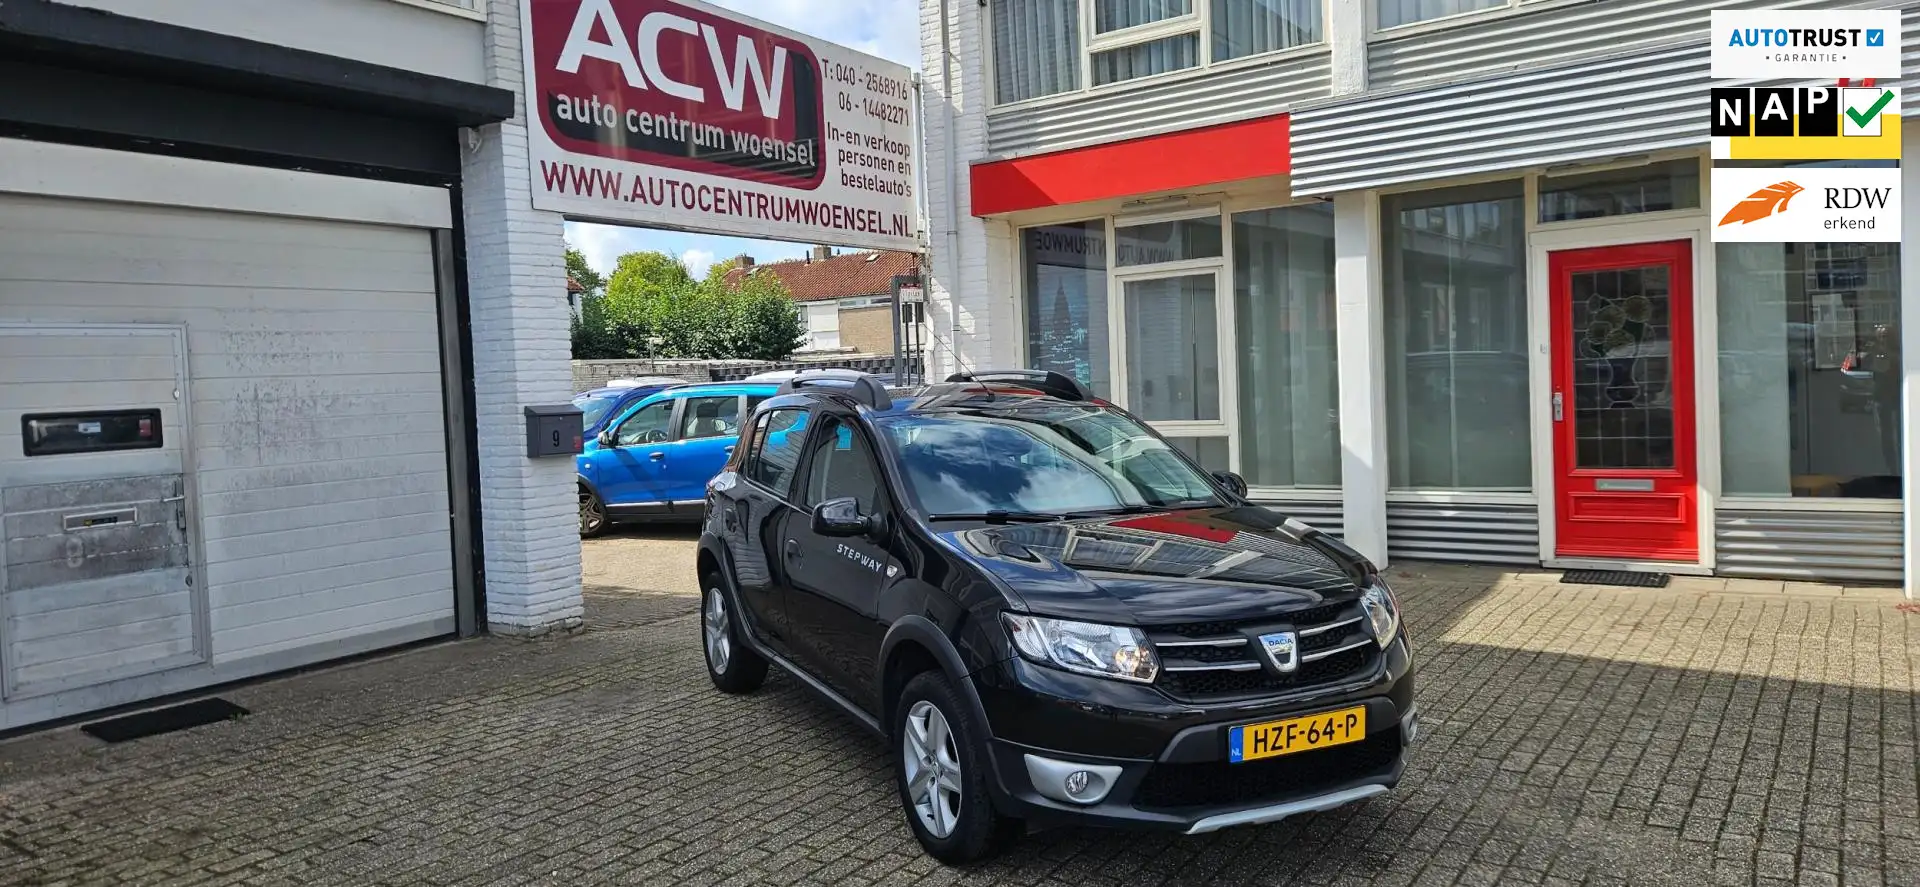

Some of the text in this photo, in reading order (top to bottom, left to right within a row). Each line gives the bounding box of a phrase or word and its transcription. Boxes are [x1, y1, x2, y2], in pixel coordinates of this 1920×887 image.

[556, 0, 787, 119] ACW
[863, 98, 909, 126] 14482271
[557, 93, 815, 167] auto centrum woensel
[827, 121, 910, 160] In-en verkoop
[838, 148, 911, 176] personen en
[841, 168, 912, 198] bestelauto's
[540, 160, 914, 238] WWW.AUTOCENTRUMWOENSEL.NL
[552, 430, 560, 447] 9
[836, 543, 882, 572] STEPWAY
[1268, 638, 1294, 647] DACIA
[1254, 713, 1358, 754] HZF-64-P
[1231, 748, 1242, 756] NL
